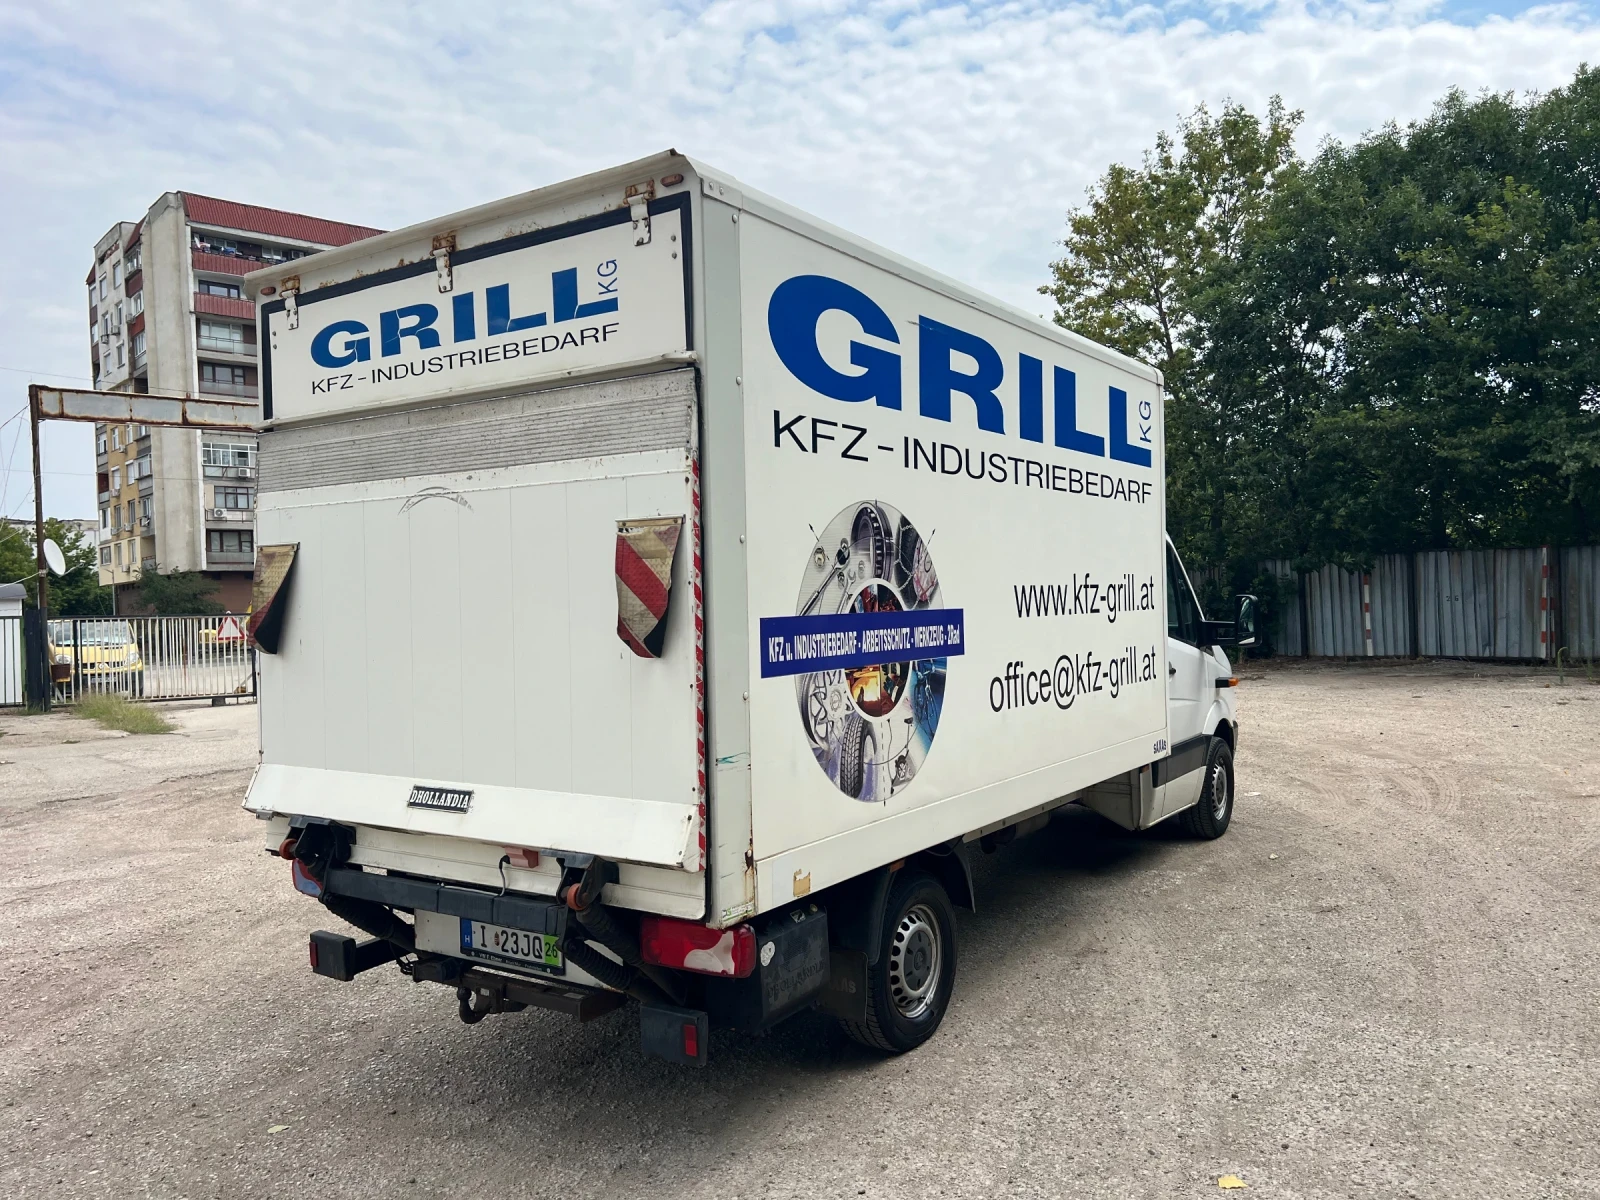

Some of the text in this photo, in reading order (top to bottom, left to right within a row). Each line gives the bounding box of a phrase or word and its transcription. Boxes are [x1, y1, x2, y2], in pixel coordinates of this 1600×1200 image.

[597, 259, 617, 295] KG
[310, 266, 618, 368] GRILL
[371, 322, 620, 385] INDUSTRIEBEDARF
[767, 274, 1152, 468] GRILL
[1138, 400, 1152, 443] KG
[773, 409, 869, 462] KFZ
[903, 436, 1152, 504] INDUSTRIEBEDARF
[1013, 573, 1155, 623] www.kfz-grill.at
[768, 636, 784, 663] KFZ
[786, 642, 793, 661] u.
[794, 631, 857, 660] INDUSTRIEBEDARF
[862, 627, 911, 653] ARBEITSSCHUTZ
[914, 625, 944, 648] WERKZEUG
[947, 624, 960, 645] 2Rad
[989, 645, 1157, 712] office@kfz-grill.at
[410, 789, 470, 808] DHOLLANDIA
[464, 934, 471, 944] H
[500, 930, 543, 959] 23JQ
